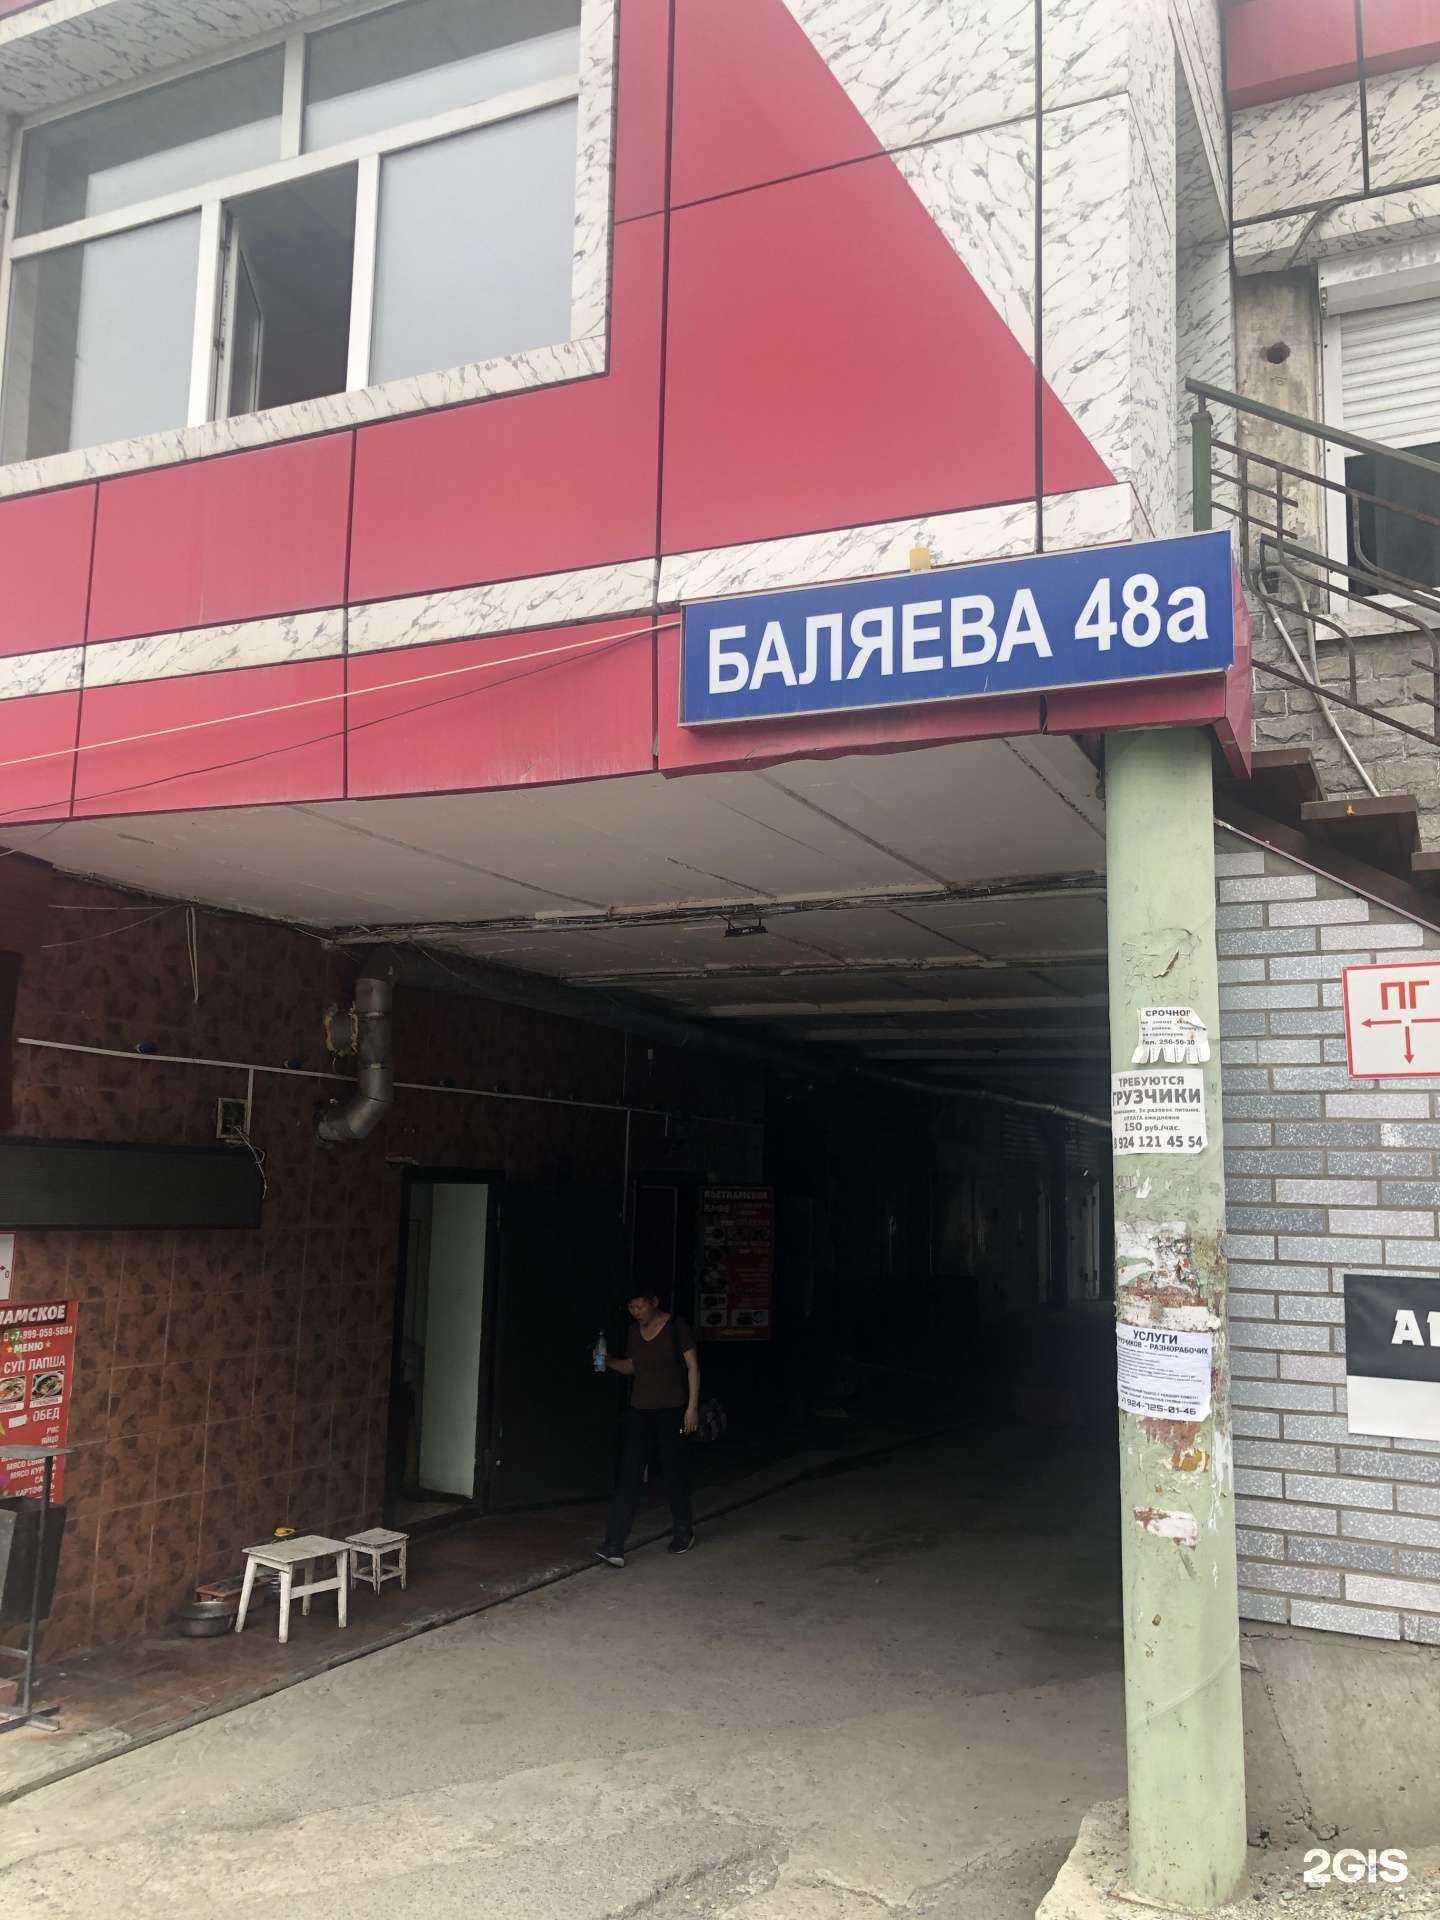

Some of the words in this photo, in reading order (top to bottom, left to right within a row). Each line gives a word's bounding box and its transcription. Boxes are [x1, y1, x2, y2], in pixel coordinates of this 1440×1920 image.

[708, 588, 1054, 695] БАЛЯЕВА
[1074, 573, 1209, 651] 48а
[1380, 979, 1430, 1011] ПГ
[1118, 1076, 1185, 1088] ТРЕБУЮТСЯ
[1112, 1088, 1201, 1107] ГРУЗЧИКИ
[1124, 1122, 1143, 1132] 150
[1118, 1136, 1135, 1149] 924
[1138, 1136, 1162, 1148] 121
[1166, 1136, 1184, 1148] 45
[1188, 1136, 1203, 1148] 54
[1133, 1329, 1178, 1345] УСЛУГИ
[14, 1342, 44, 1353] МЕНЮ
[1149, 1343, 1209, 1355] РАЗНОРАБОЧИХ
[4, 1358, 26, 1374] СУП
[28, 1355, 66, 1372] ЛАПША
[32, 1407, 60, 1422] ОБЕД
